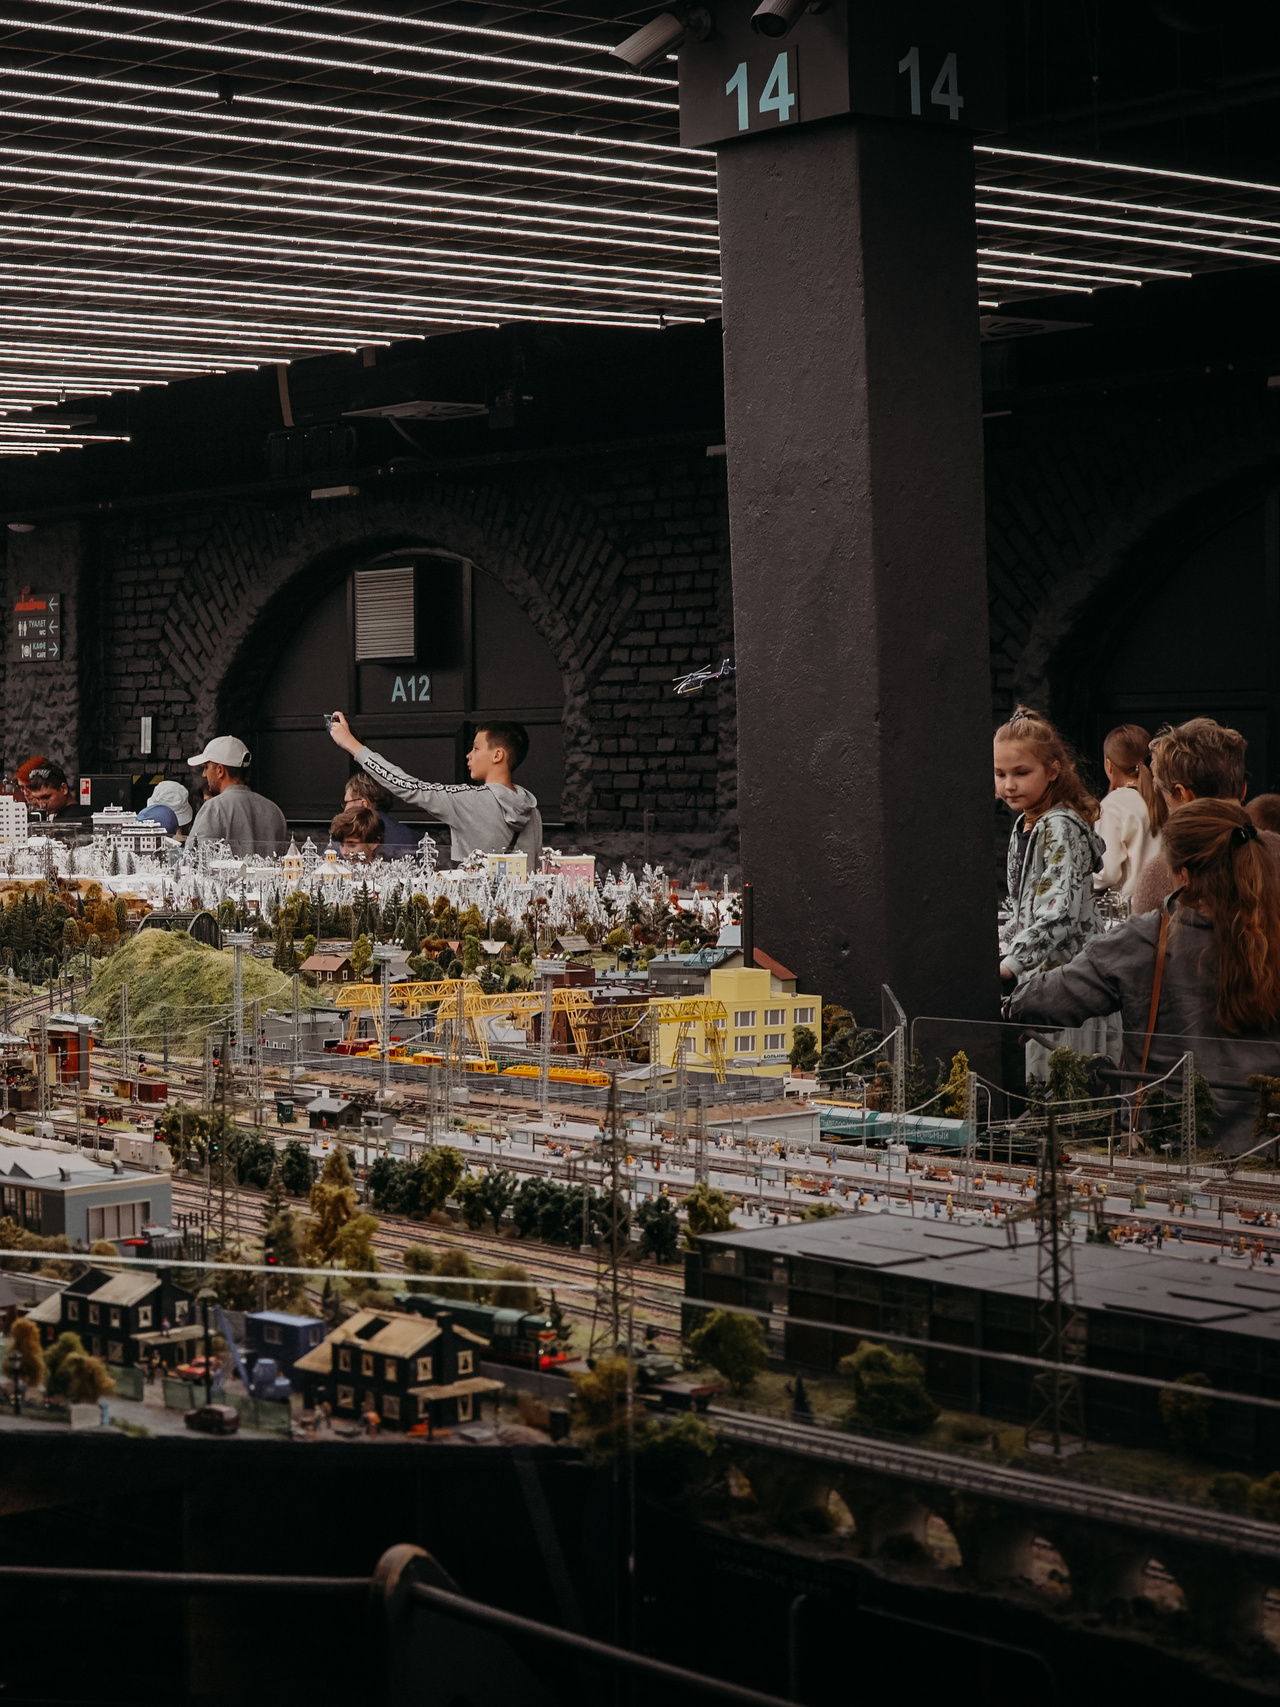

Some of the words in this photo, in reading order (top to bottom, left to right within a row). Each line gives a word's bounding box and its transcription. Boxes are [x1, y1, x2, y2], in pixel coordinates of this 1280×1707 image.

[725, 52, 795, 131] 14
[898, 46, 965, 121] 14
[28, 619, 46, 628] ТУАЛЕТ
[32, 641, 46, 650] КАФЕ
[391, 675, 430, 703] A12
